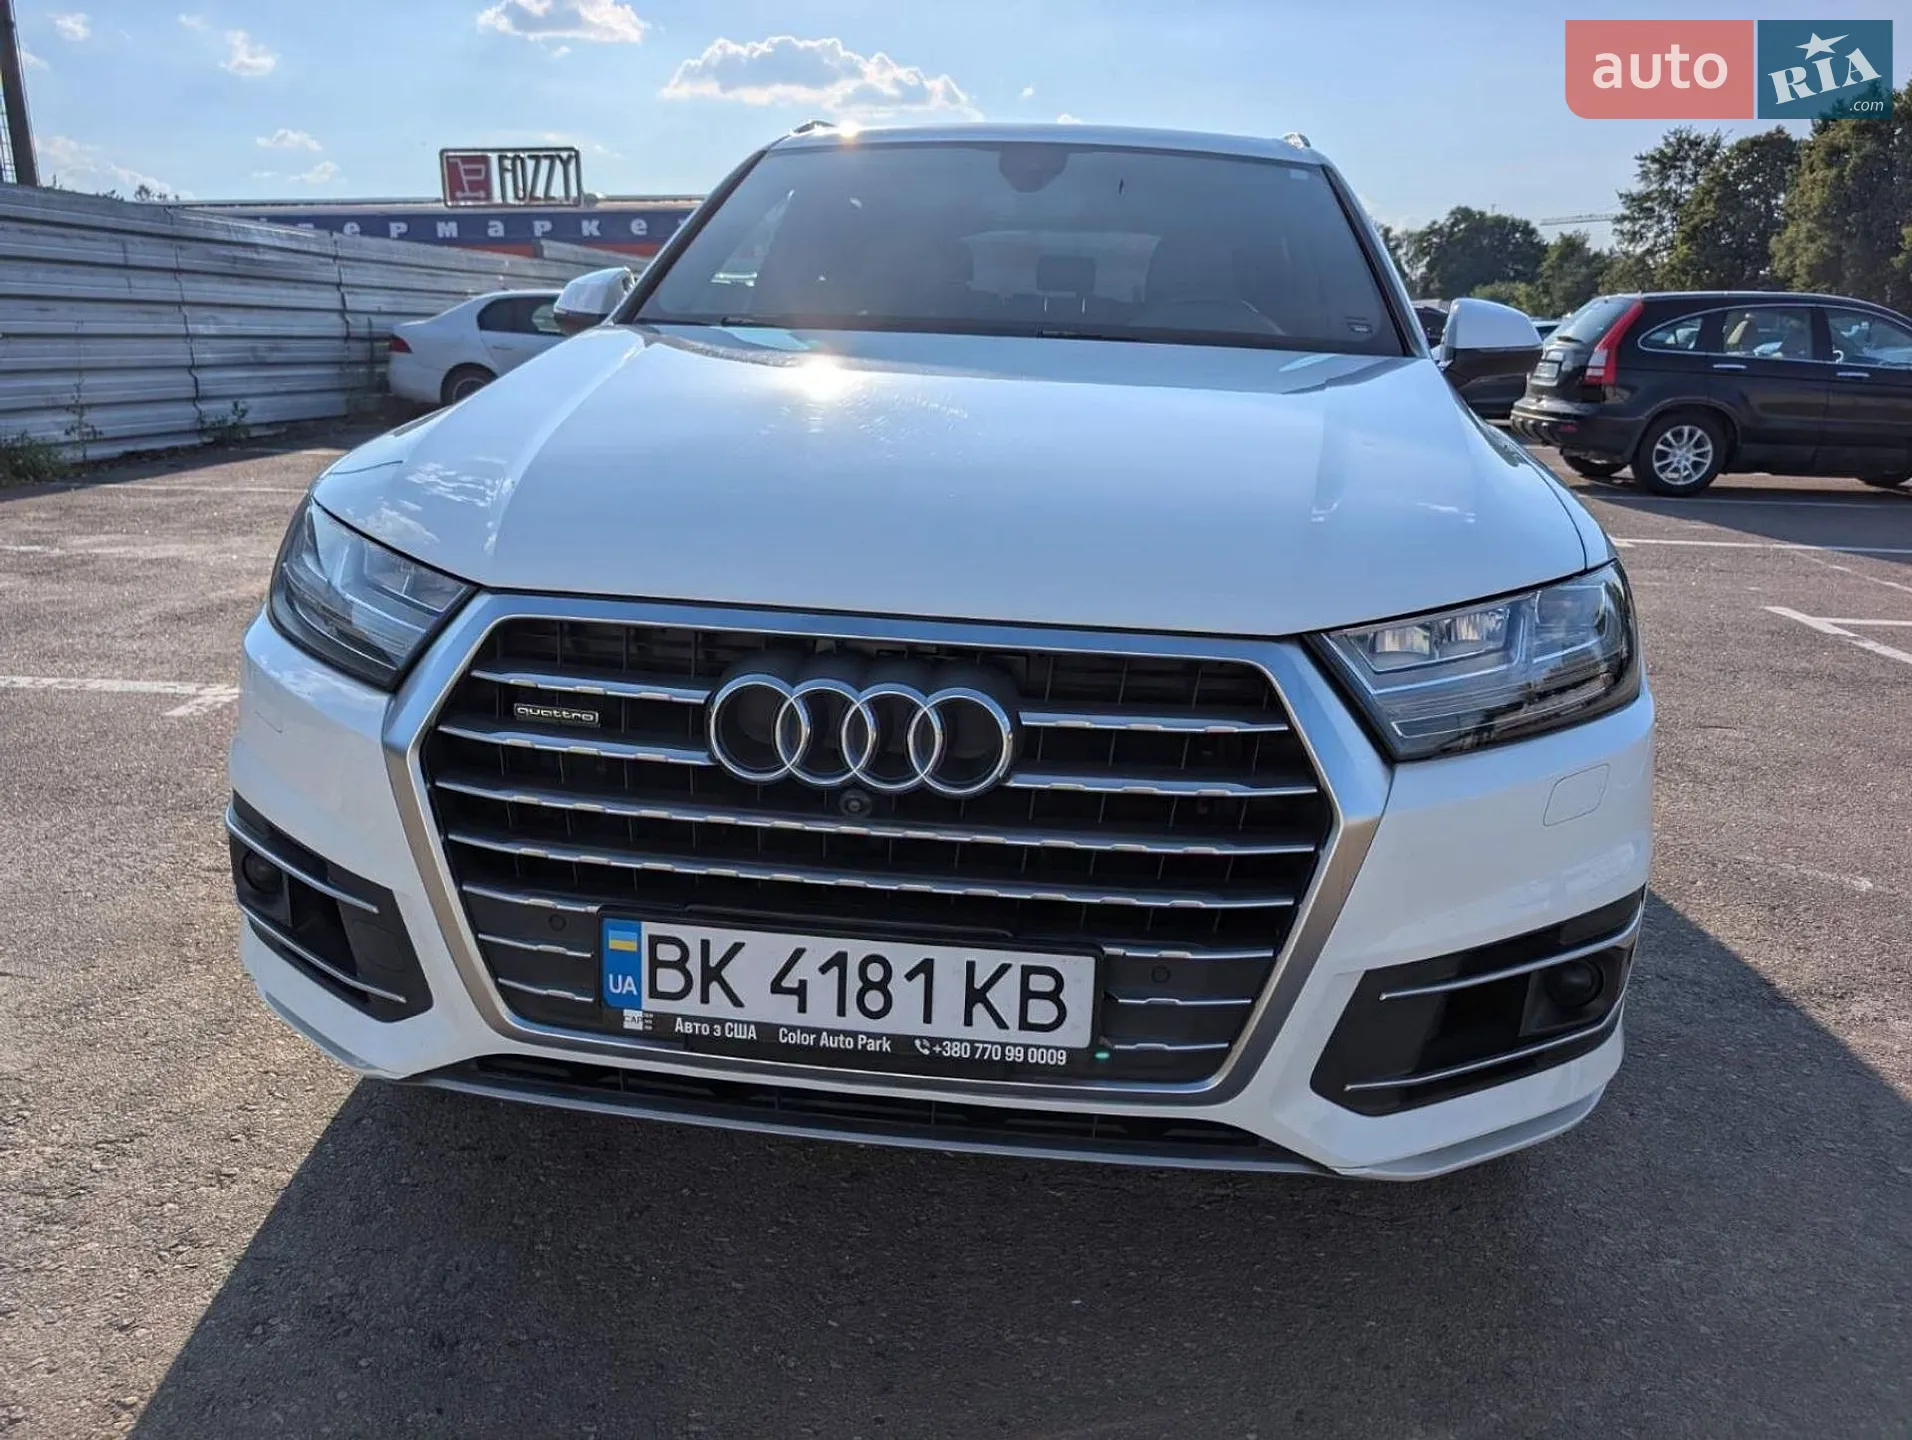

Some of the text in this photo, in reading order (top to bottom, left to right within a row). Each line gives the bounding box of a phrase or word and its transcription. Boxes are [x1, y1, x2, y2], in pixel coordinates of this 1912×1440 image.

[499, 153, 575, 202] FOZZY
[517, 707, 594, 721] quattro
[608, 974, 638, 996] UA
[648, 933, 1068, 1033] BK 4181 KB
[674, 1016, 710, 1037] Авто
[713, 1024, 722, 1037] з
[724, 1021, 757, 1041] США
[778, 1027, 891, 1053] Color Auto Park
[932, 1040, 1067, 1066] +380 770 99 0009
